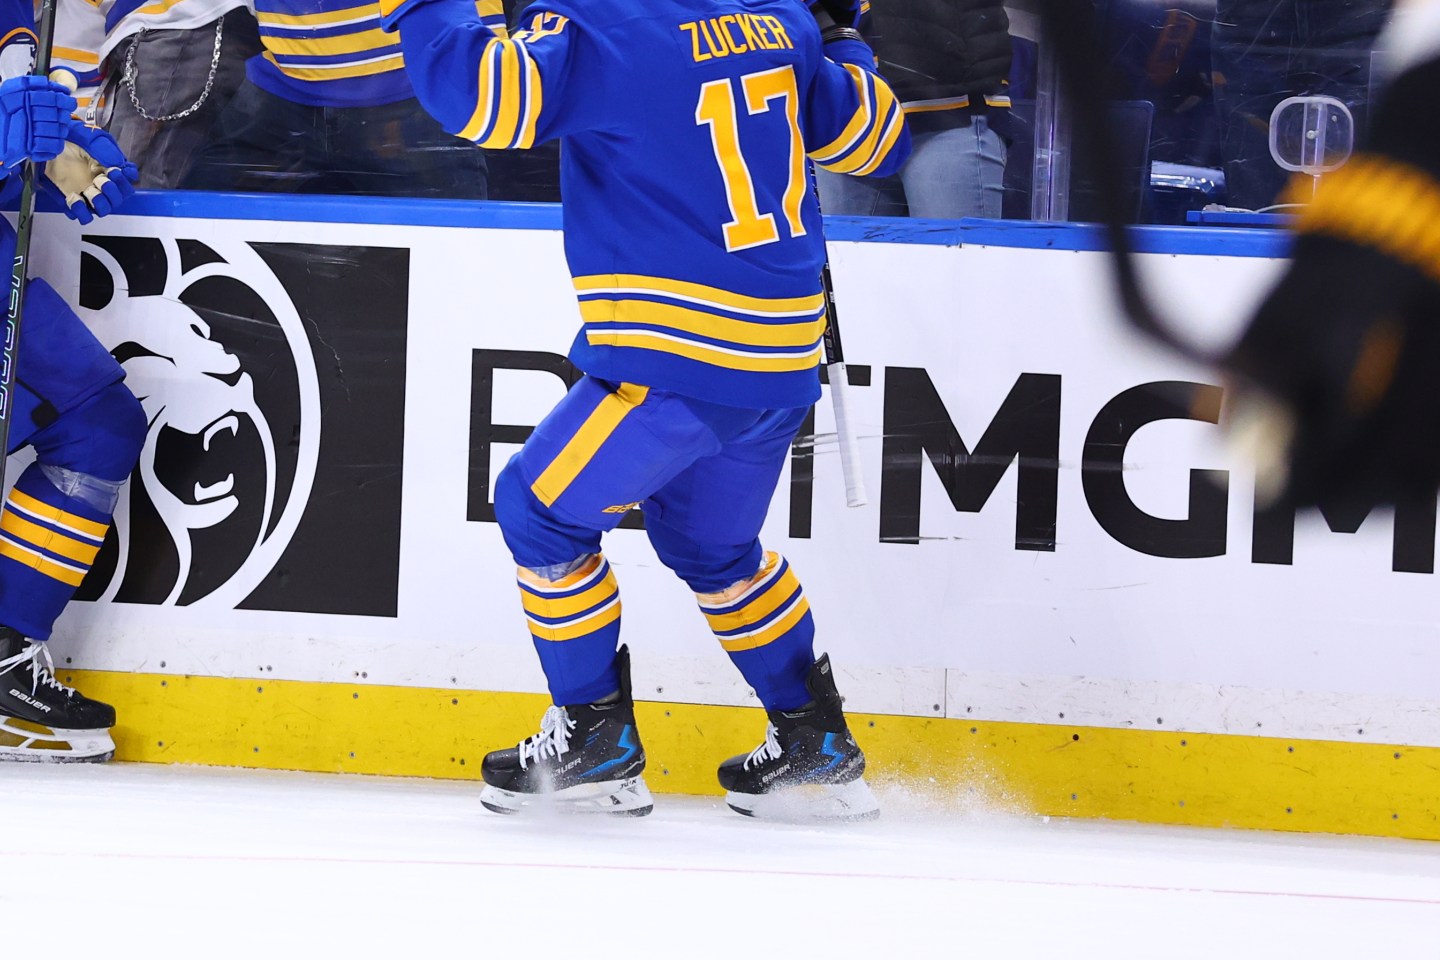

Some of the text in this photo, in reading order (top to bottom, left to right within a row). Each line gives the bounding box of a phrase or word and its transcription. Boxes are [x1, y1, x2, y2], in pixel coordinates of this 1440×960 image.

[678, 13, 794, 63] ZUCKER
[695, 64, 807, 253] 17
[8, 688, 52, 714] BAUER
[551, 756, 583, 777] AUER
[761, 762, 791, 784] BAUER
